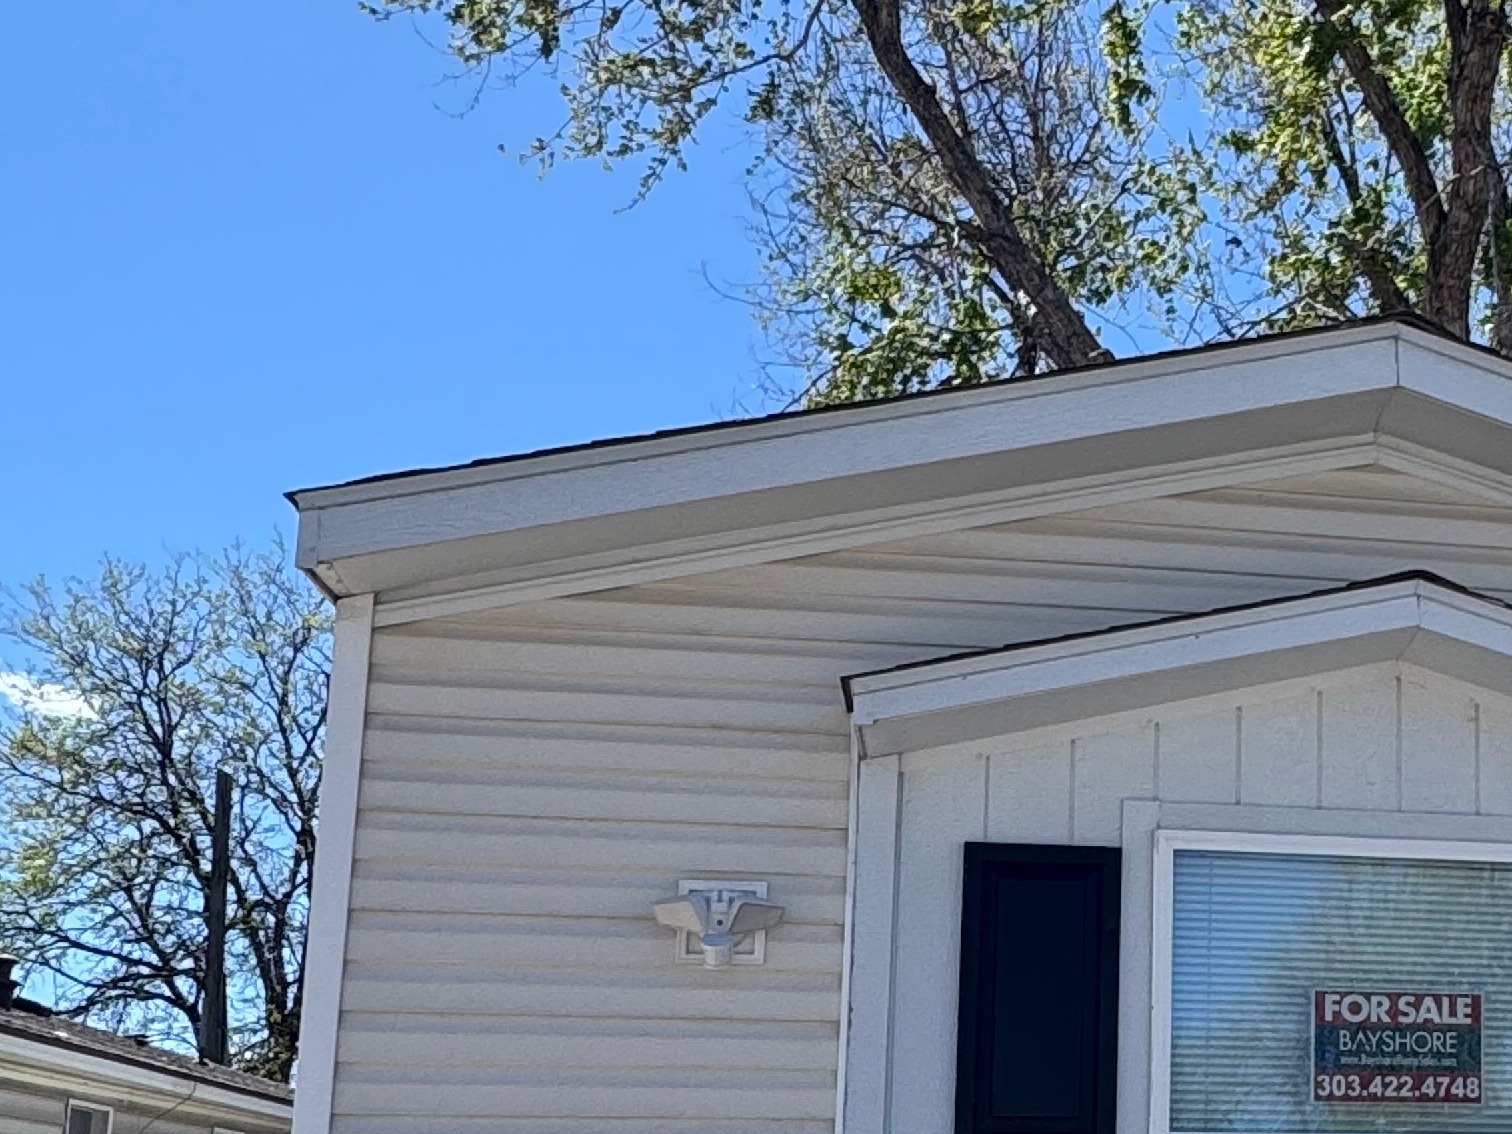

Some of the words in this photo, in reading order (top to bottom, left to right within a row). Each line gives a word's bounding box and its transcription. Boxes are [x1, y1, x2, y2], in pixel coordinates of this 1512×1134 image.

[1324, 993, 1391, 1023] FOR
[1397, 995, 1472, 1025] SALE
[1338, 1029, 1458, 1053] BAYSHORE
[1316, 1074, 1480, 1098] 303.422.4748
